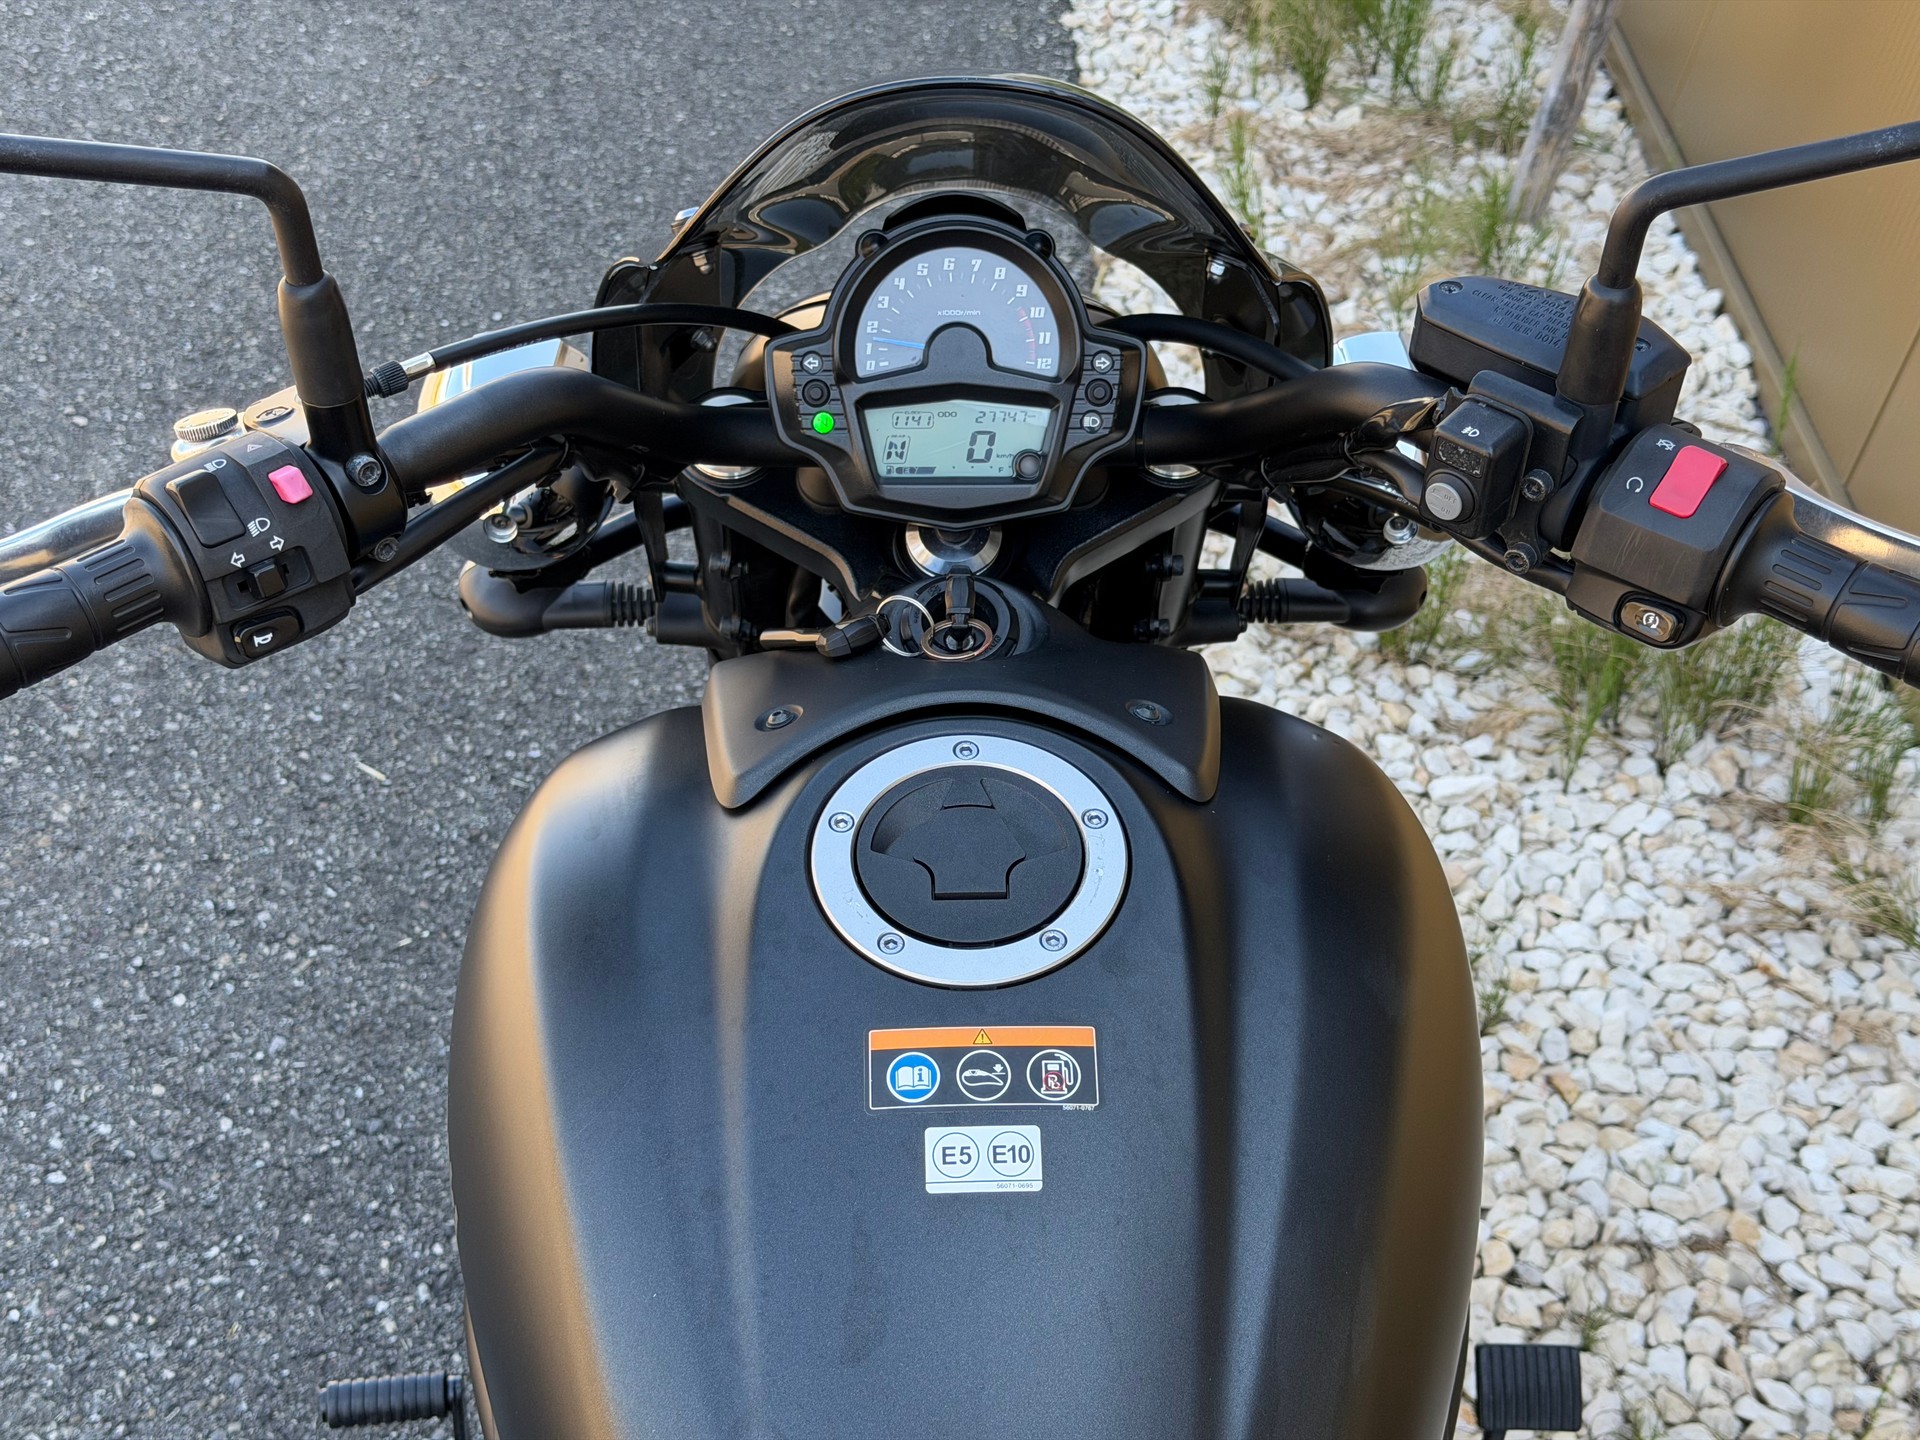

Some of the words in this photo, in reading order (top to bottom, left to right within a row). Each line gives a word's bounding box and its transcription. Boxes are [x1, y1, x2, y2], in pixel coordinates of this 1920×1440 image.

[917, 263, 929, 276] 5
[943, 258, 955, 270] 6
[971, 259, 982, 272] 7
[994, 267, 1006, 280] 8
[893, 278, 906, 290] 4
[1015, 284, 1028, 297] 9
[877, 296, 890, 308] 3
[1541, 299, 1567, 311] DOT4
[936, 309, 981, 317] x1000r/min
[1030, 306, 1045, 318] 10
[866, 321, 878, 333] 2
[1038, 332, 1051, 344] 11
[866, 343, 872, 354] 1
[866, 361, 876, 371] 0
[1036, 358, 1052, 369] 12
[975, 410, 1028, 424] 27747
[886, 440, 907, 461] N
[966, 430, 997, 463] 0
[941, 1145, 972, 1165] E5
[992, 1144, 1031, 1164] E10
